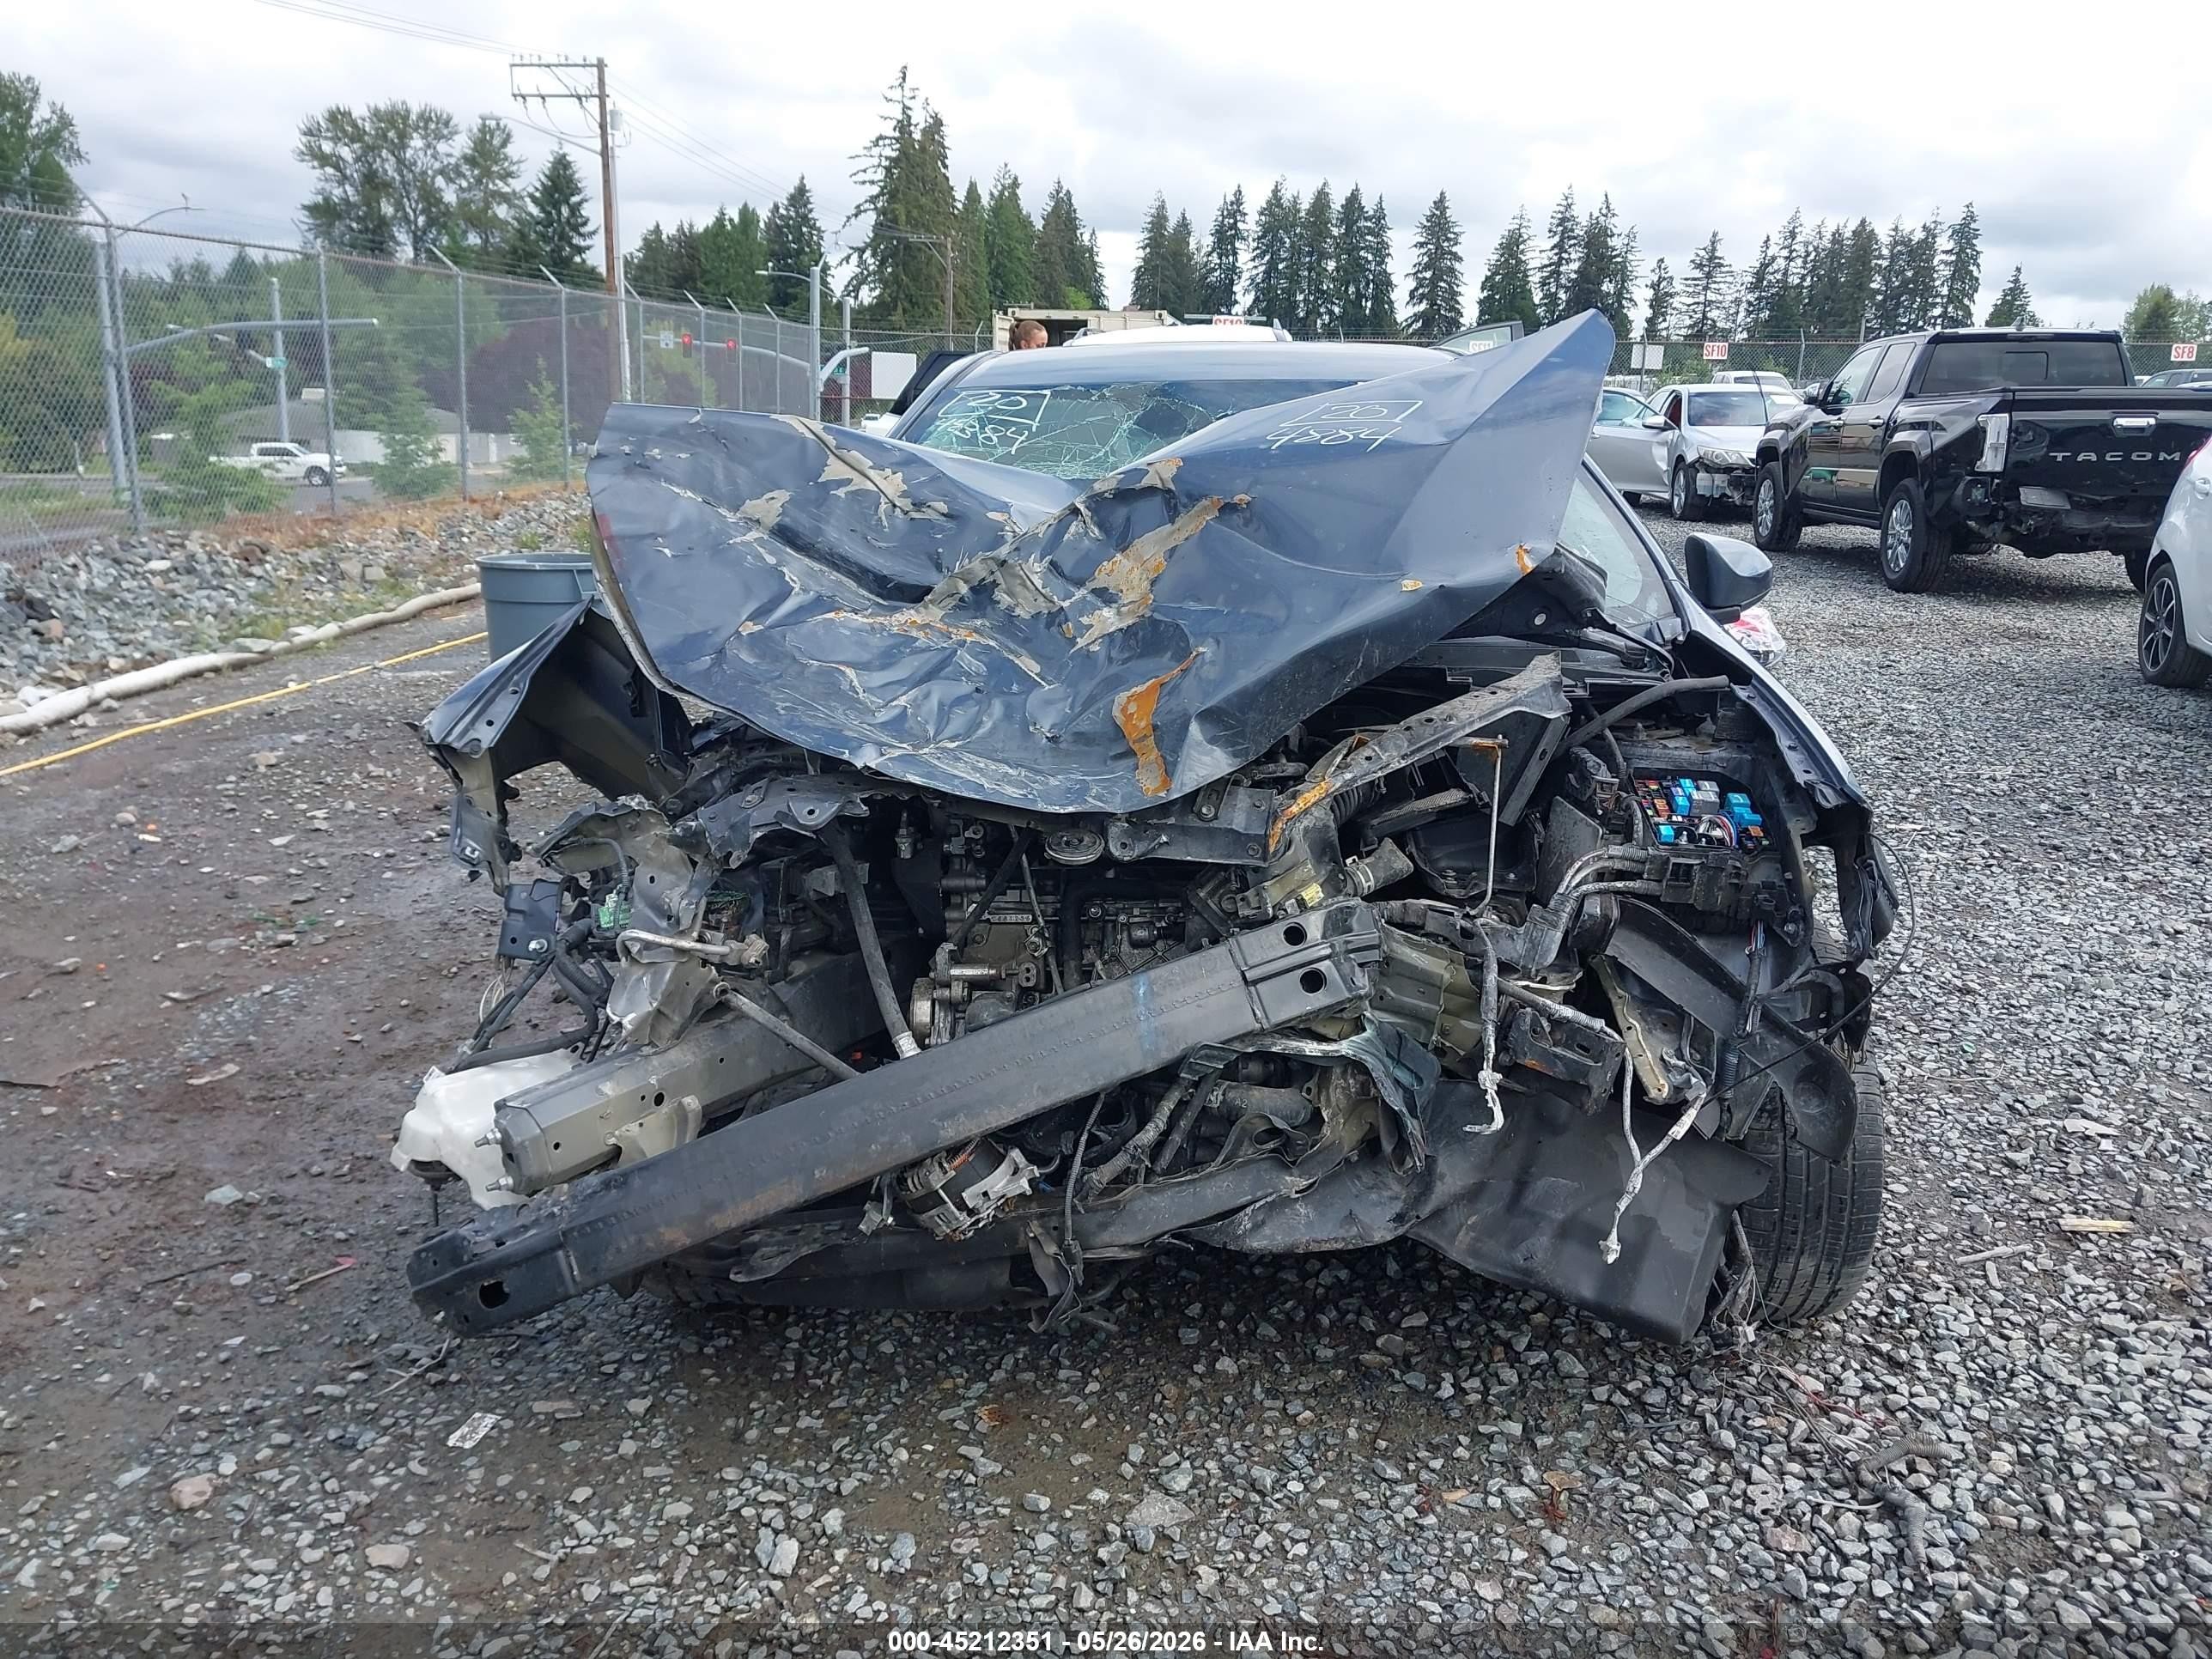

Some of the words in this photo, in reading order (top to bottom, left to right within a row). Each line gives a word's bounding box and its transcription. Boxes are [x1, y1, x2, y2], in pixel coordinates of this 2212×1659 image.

[1705, 343, 1727, 357] SF10
[2173, 345, 2195, 359] SF8
[967, 392, 1028, 410] 20
[1321, 404, 1389, 419] 20
[1266, 425, 1403, 453] 4884
[2048, 452, 2182, 462] TACOM
